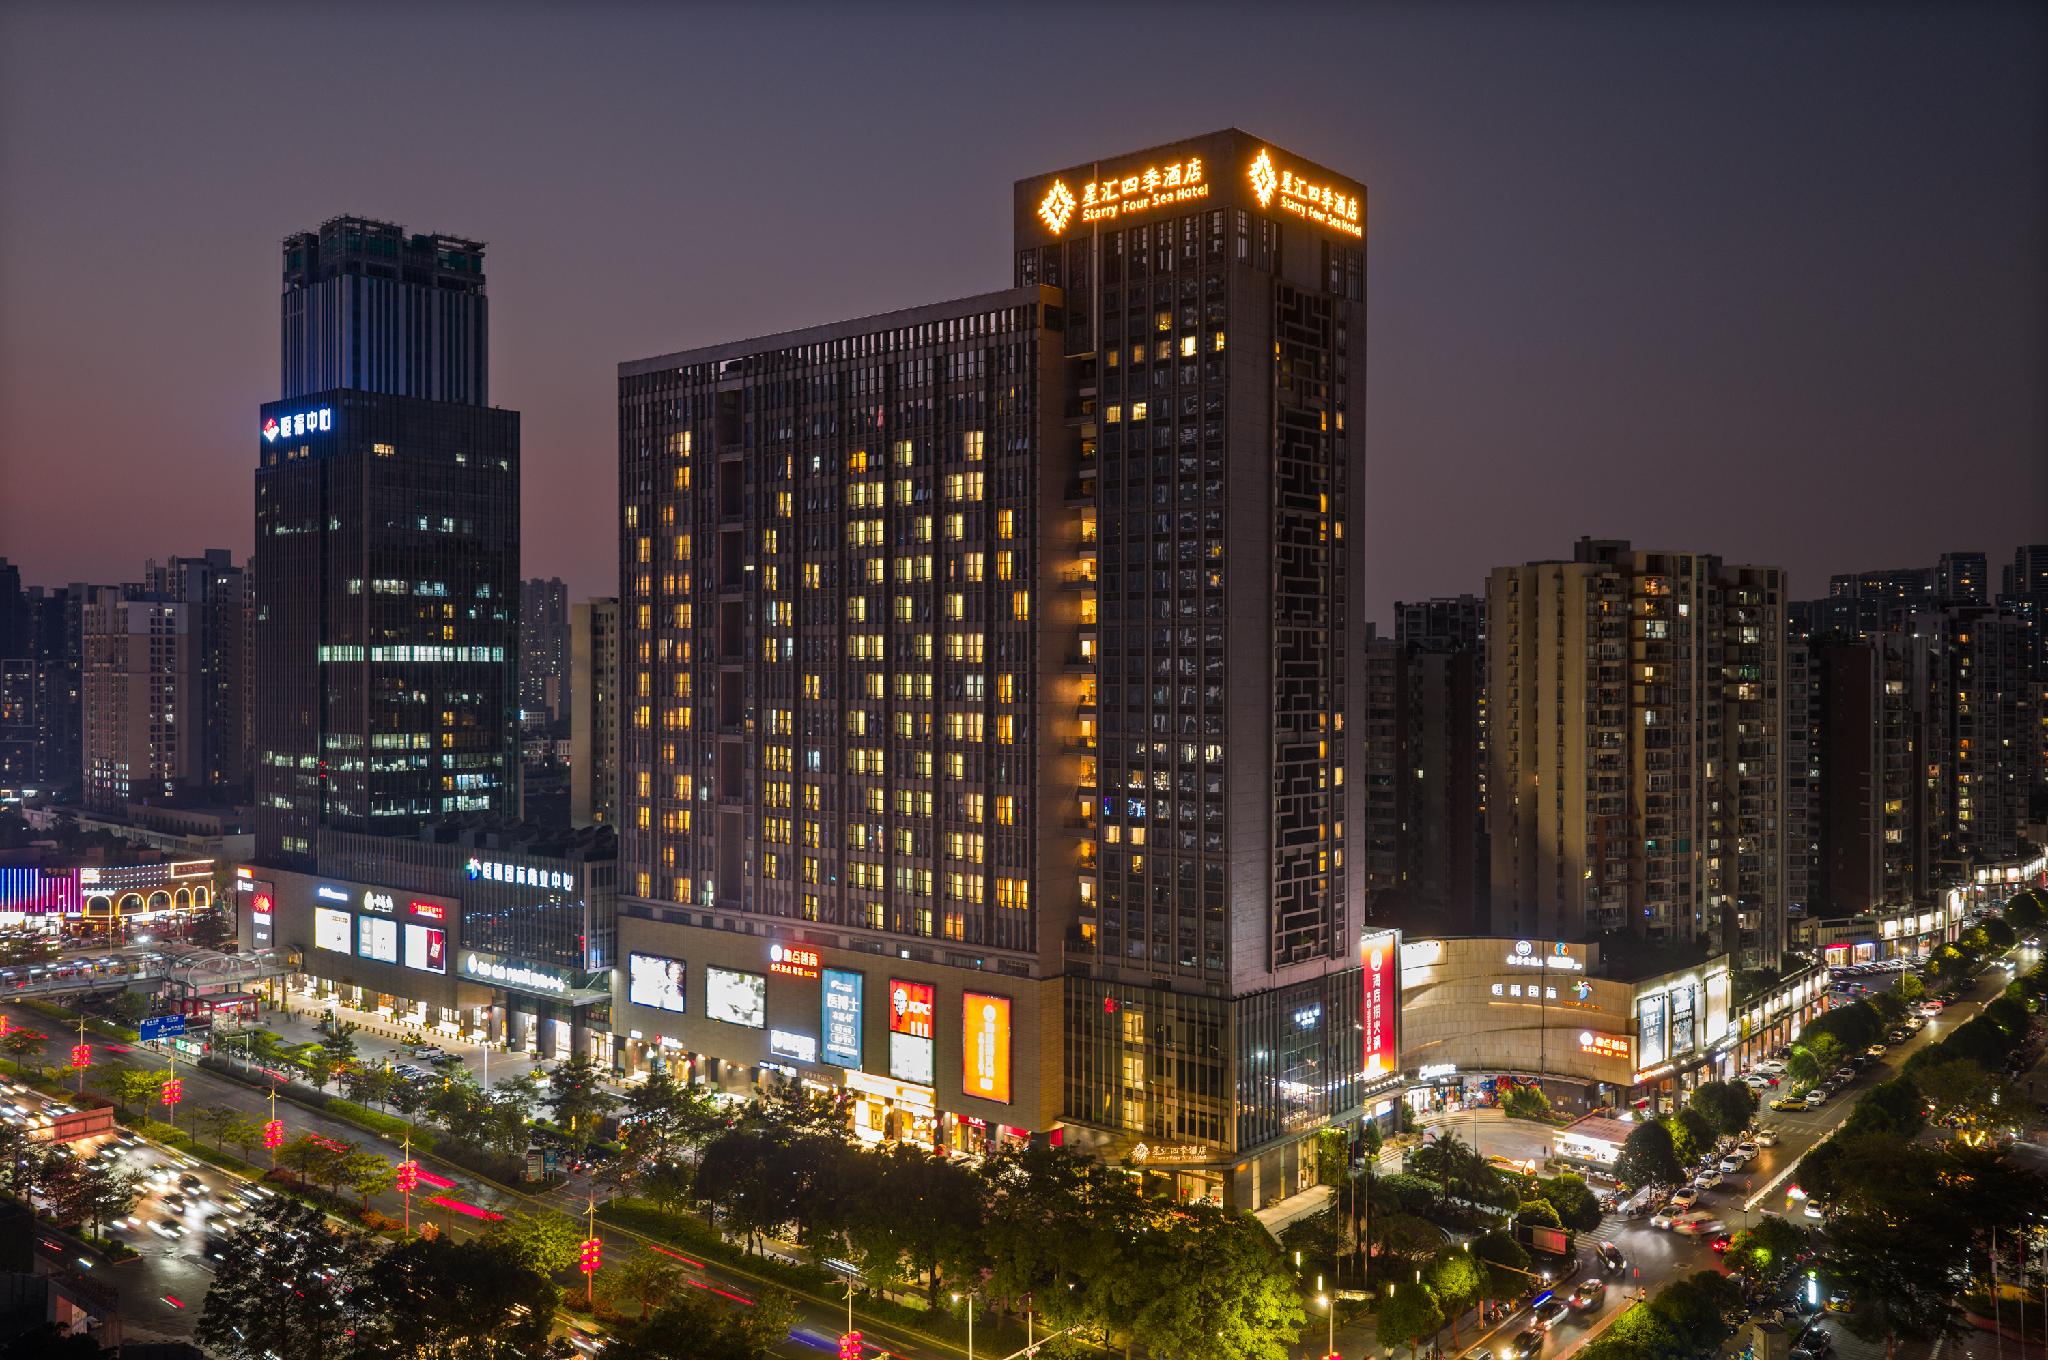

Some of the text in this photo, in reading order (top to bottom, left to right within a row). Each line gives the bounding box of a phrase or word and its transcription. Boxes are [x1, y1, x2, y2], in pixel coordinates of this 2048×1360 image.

[1082, 157, 1202, 208] 星汇四季酒店
[1082, 183, 1208, 222] Starry Four Sea Hotel
[1281, 171, 1358, 221] 星汇四季酒店
[1281, 196, 1362, 238] Starry Four Sea Hotel
[1372, 973, 1381, 1051] 海底捞火锅
